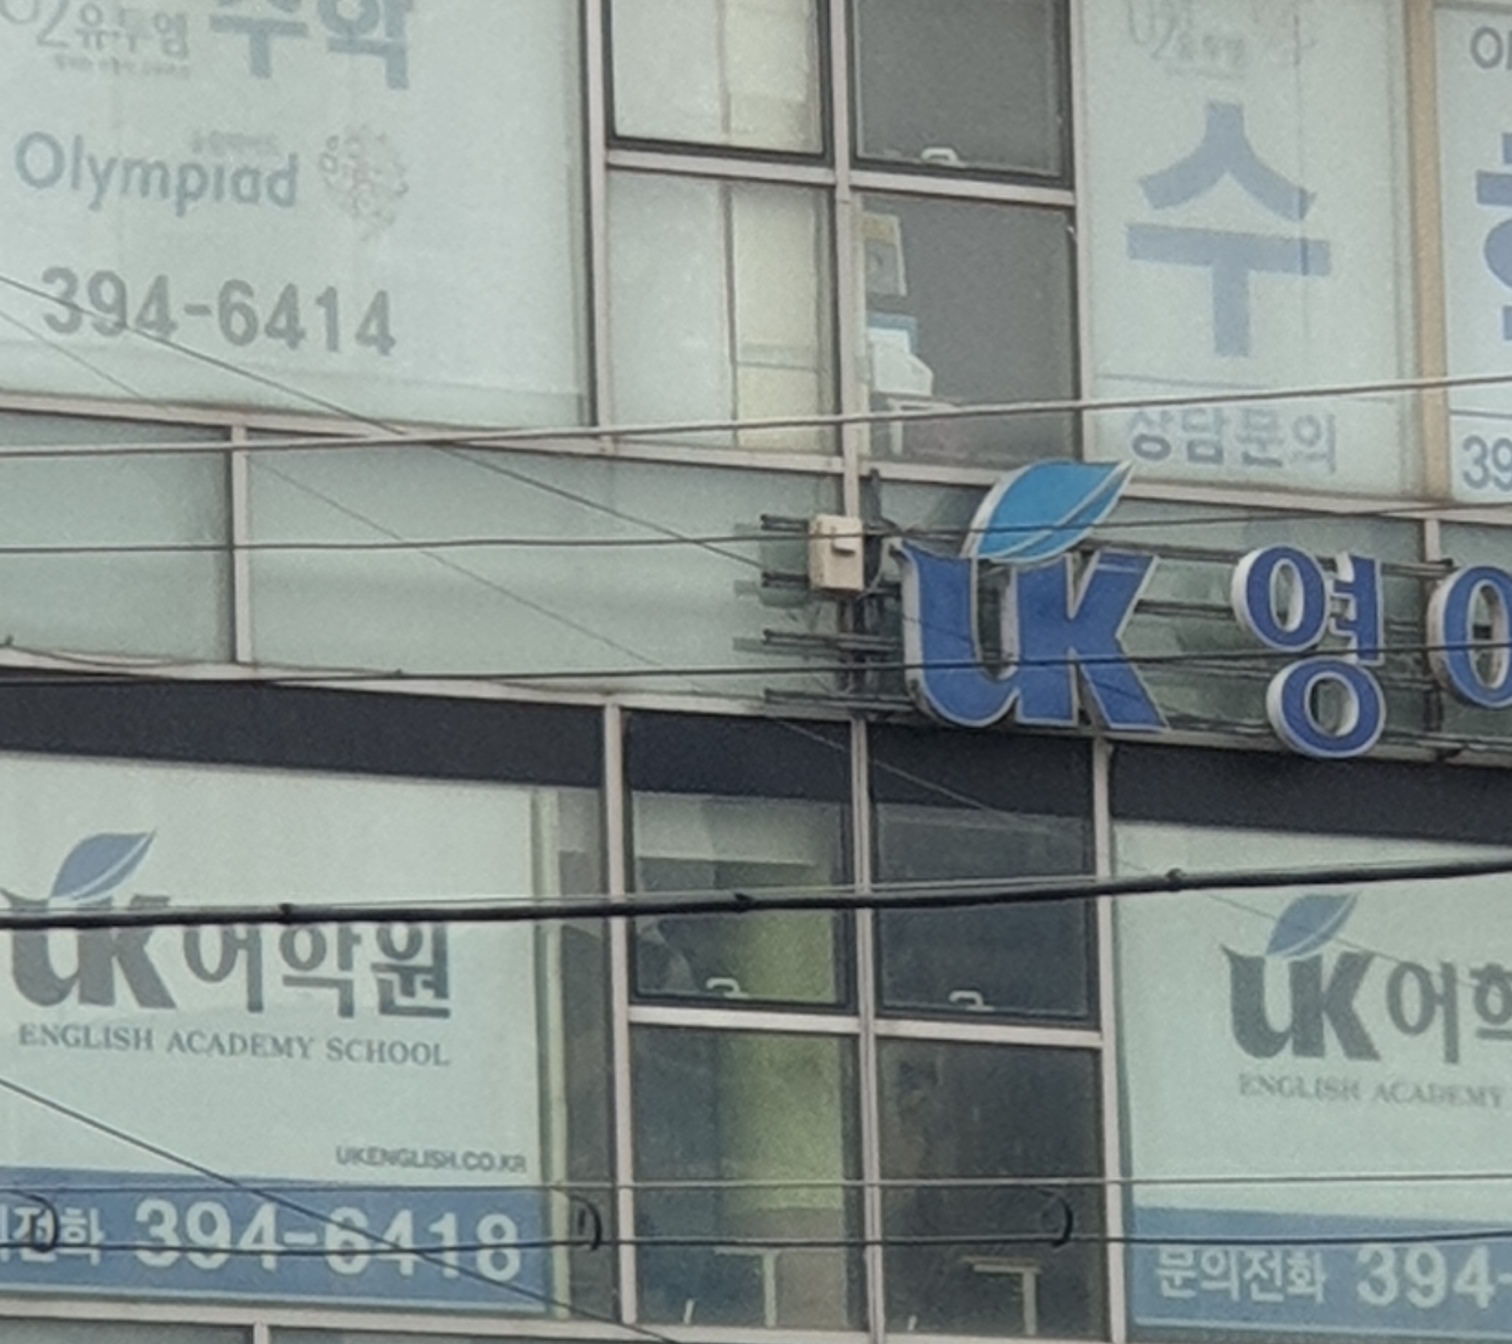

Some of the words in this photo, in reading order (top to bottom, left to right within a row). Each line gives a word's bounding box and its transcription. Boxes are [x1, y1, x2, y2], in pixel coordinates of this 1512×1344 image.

[15, 131, 299, 216] Olympiad
[41, 266, 396, 356] 394-6414
[1127, 408, 1338, 474] 상담문의
[18, 1022, 155, 1052] ENGLISH
[166, 1030, 315, 1061] ACADEMY
[325, 1036, 451, 1068] SCHOOL
[1238, 1072, 1360, 1102] ENGLISH
[1373, 1080, 1506, 1110] ACADEMY
[0, 1205, 105, 1267] 전화
[133, 1197, 522, 1284] 394-6418
[1155, 1247, 1326, 1304] 문의전화
